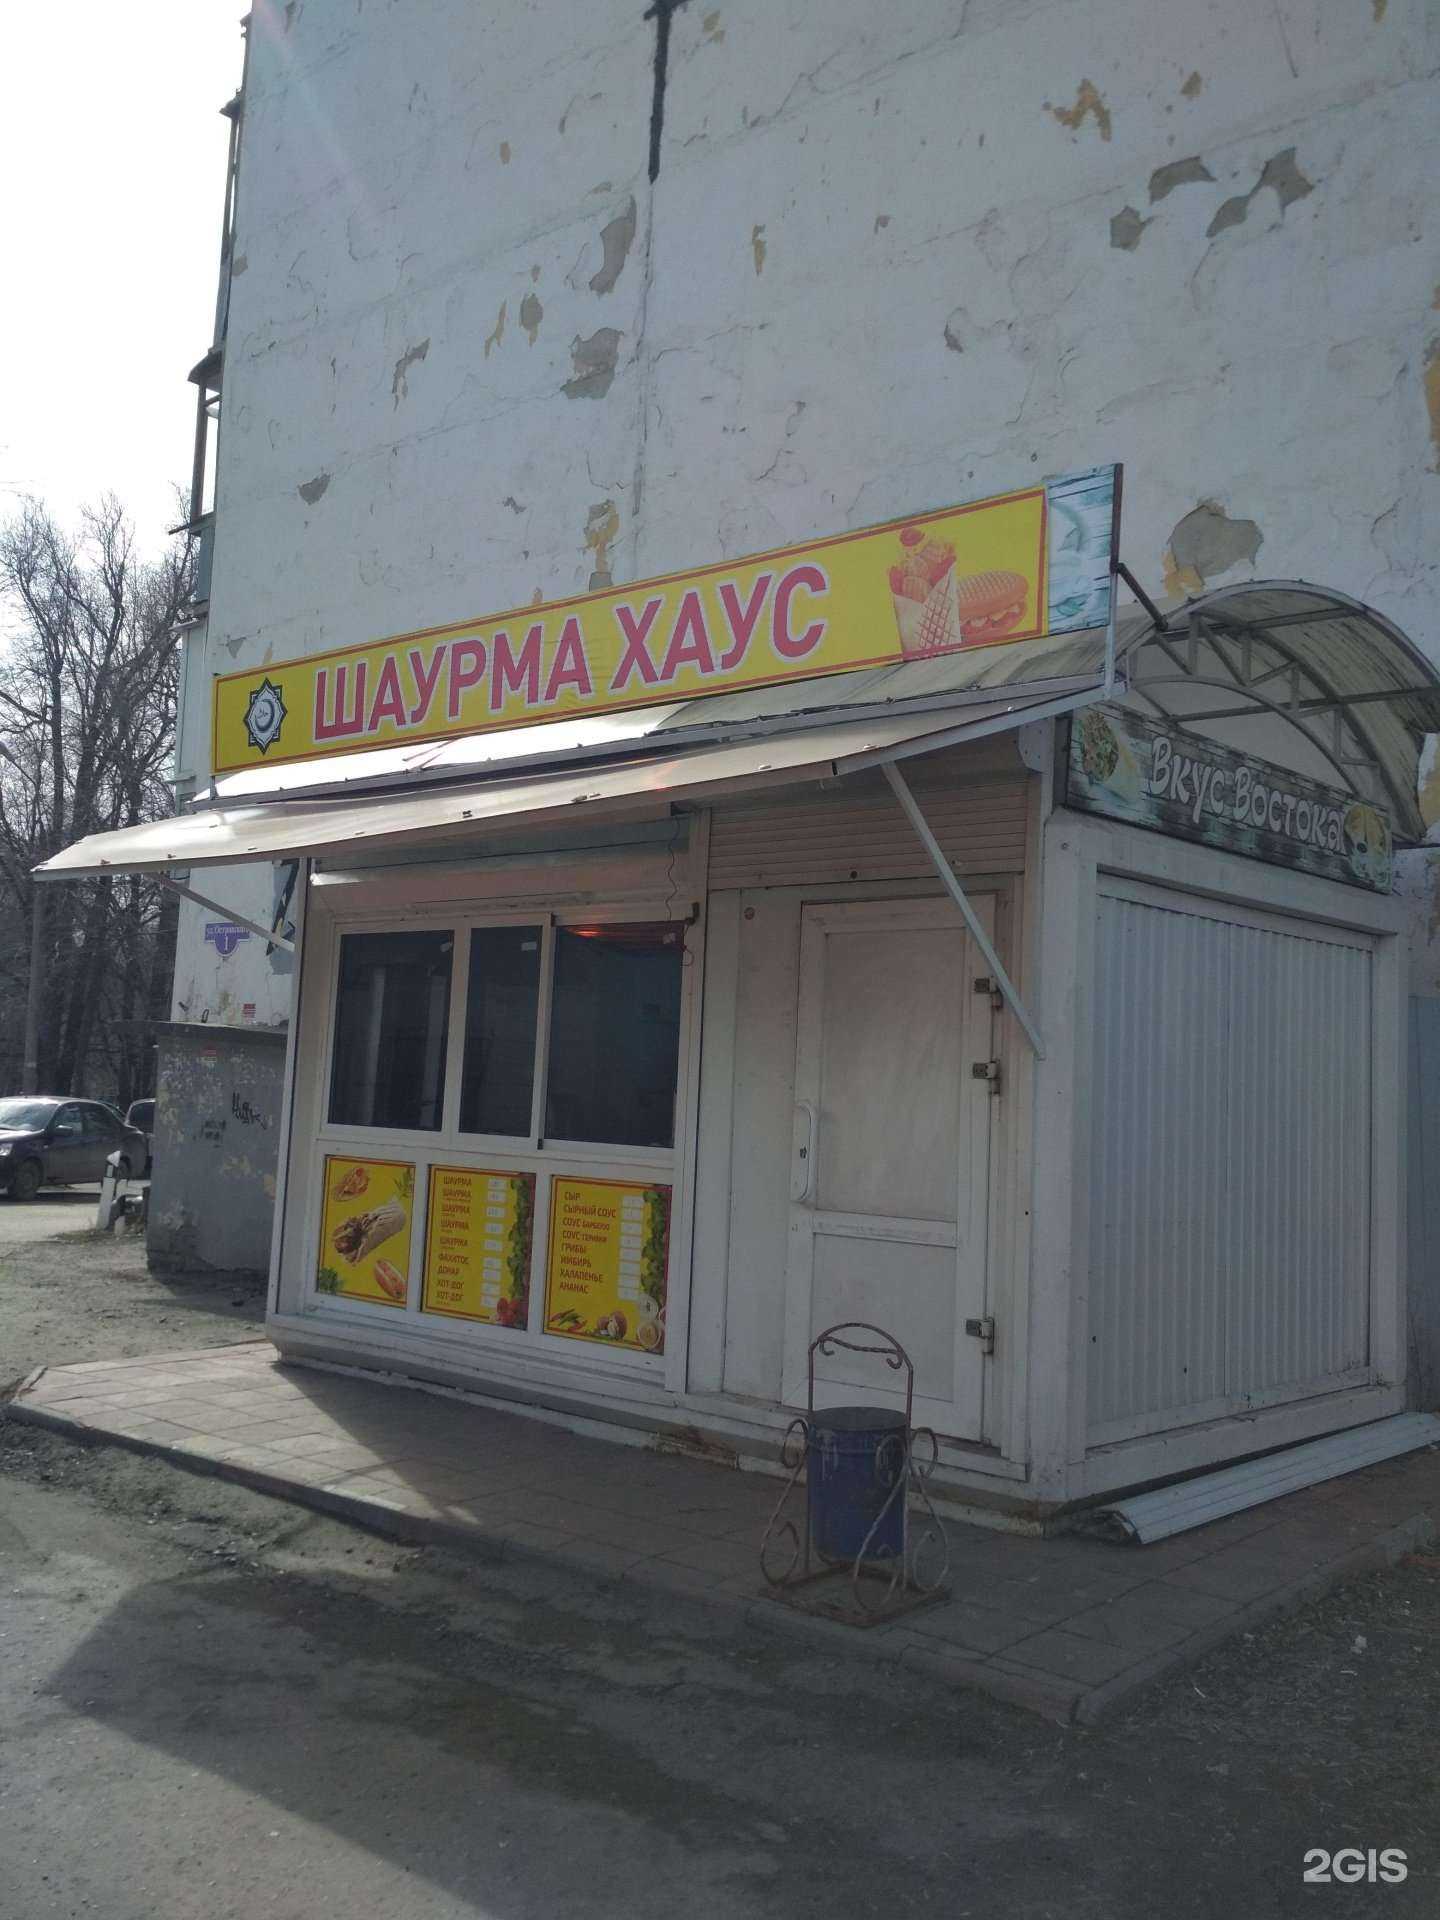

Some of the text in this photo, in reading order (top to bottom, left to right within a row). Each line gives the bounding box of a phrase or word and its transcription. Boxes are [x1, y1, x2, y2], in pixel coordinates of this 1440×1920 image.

[312, 564, 828, 740] ШАУРМА ХАУС
[1150, 737, 1347, 850] Вкус Востока
[443, 1176, 472, 1186] ШАУРМА
[564, 1191, 581, 1201] СЫР
[563, 1204, 617, 1218] СЫРНЫЙ СОУС
[562, 1217, 581, 1227] СОУС
[562, 1230, 580, 1241] СОУС
[561, 1243, 586, 1254] ГРИБЫ
[560, 1257, 592, 1268] ИМБИРЬ
[560, 1268, 603, 1283] ХАЛАПЕНЬЕ
[559, 1282, 589, 1294] АНАНАС
